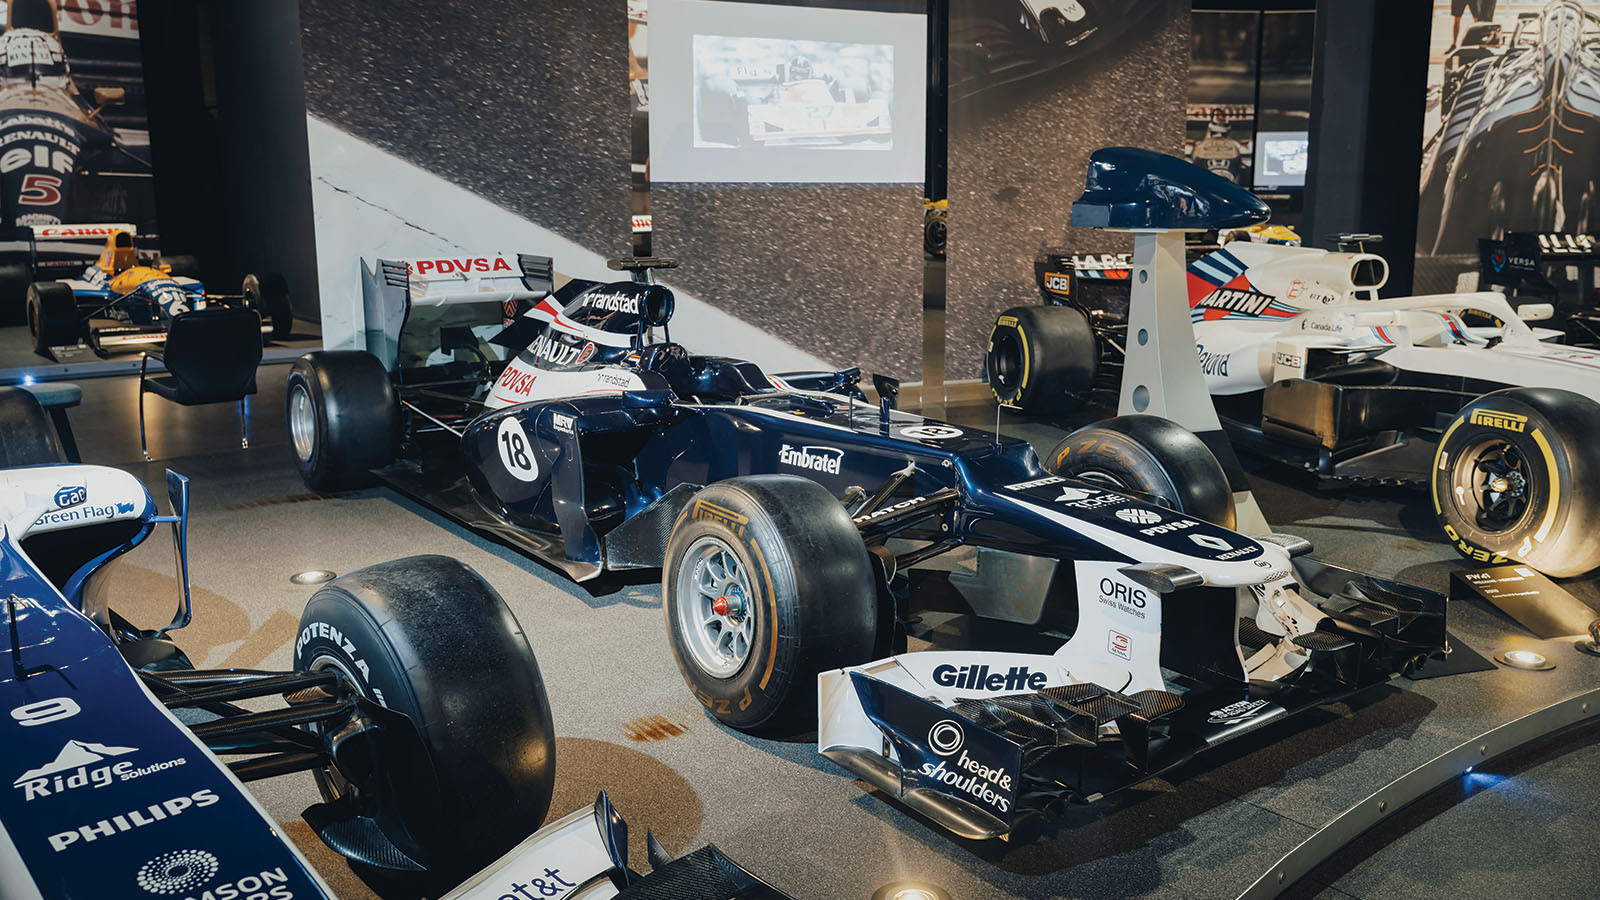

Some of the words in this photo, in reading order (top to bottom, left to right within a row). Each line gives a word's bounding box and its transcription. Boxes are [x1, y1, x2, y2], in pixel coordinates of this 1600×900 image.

[0, 145, 74, 174] elf
[18, 174, 62, 206] 5
[416, 258, 512, 275] PDVSA
[1508, 257, 1535, 266] VERSA
[1046, 276, 1067, 291] JCB
[1201, 289, 1272, 315] ARTINI
[1311, 321, 1331, 332] Canada
[1277, 353, 1301, 368] JCB
[498, 366, 537, 396] PDVSA
[1470, 408, 1528, 433] PIRELLI
[501, 430, 532, 470] 18
[779, 444, 844, 475] Embratel
[1057, 446, 1070, 469] P
[83, 505, 114, 519] Flag
[692, 499, 748, 538] PIRELLI
[1139, 519, 1200, 537] PDVSA
[1215, 545, 1259, 561] RENAULT
[1443, 524, 1508, 564] ZERO
[1517, 535, 1532, 558] P
[1098, 594, 1117, 609] Swiss
[1117, 602, 1146, 620] Watches
[1100, 577, 1147, 609] ORIS
[297, 622, 369, 684] POTENZA
[932, 663, 1048, 692] Gillette
[10, 697, 81, 727] 9
[16, 759, 134, 802] Ridge
[917, 760, 1011, 813] shoulders
[48, 789, 220, 853] PHILIPS
